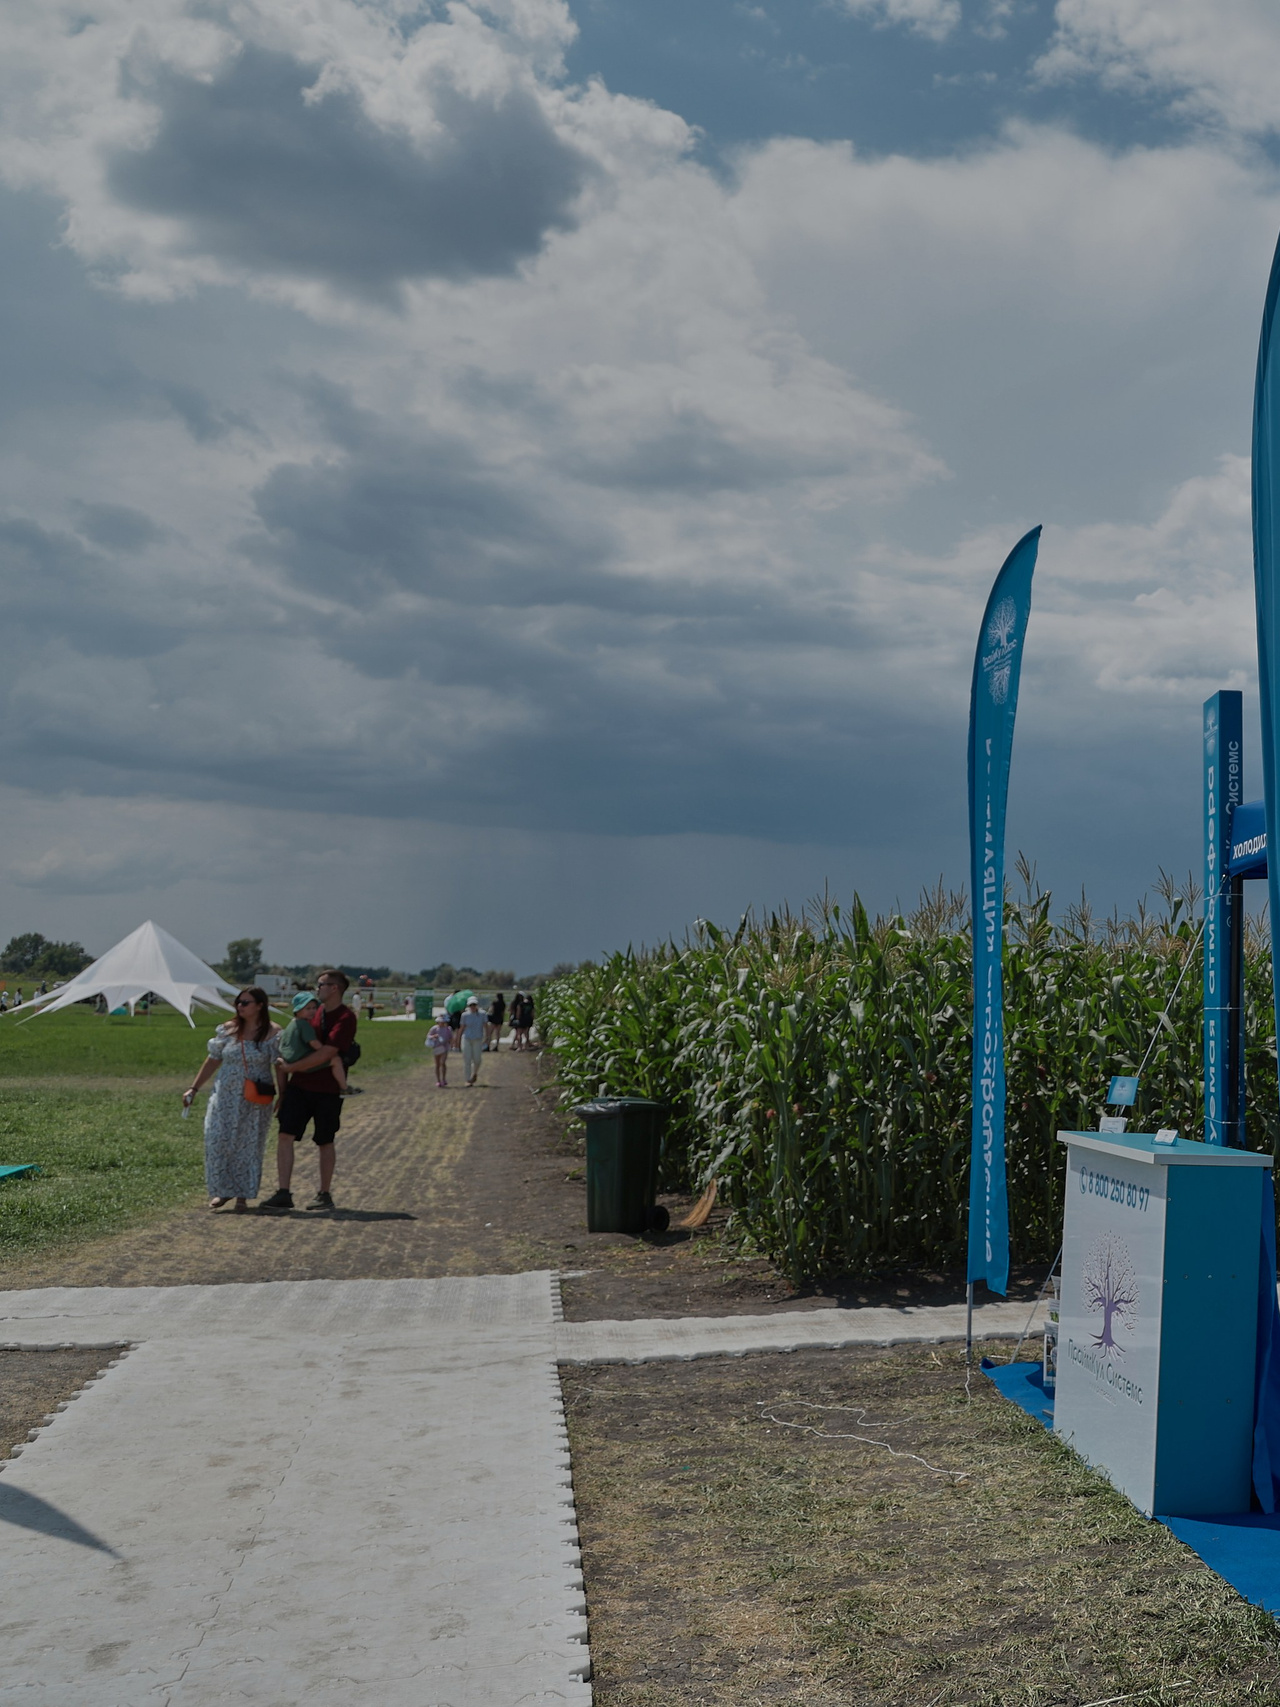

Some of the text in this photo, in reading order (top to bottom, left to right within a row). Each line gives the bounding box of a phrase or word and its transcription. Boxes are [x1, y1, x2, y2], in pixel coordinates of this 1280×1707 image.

[1088, 1171, 1150, 1212] 8 800 250 80 97
[1106, 1362, 1144, 1404] Системс
